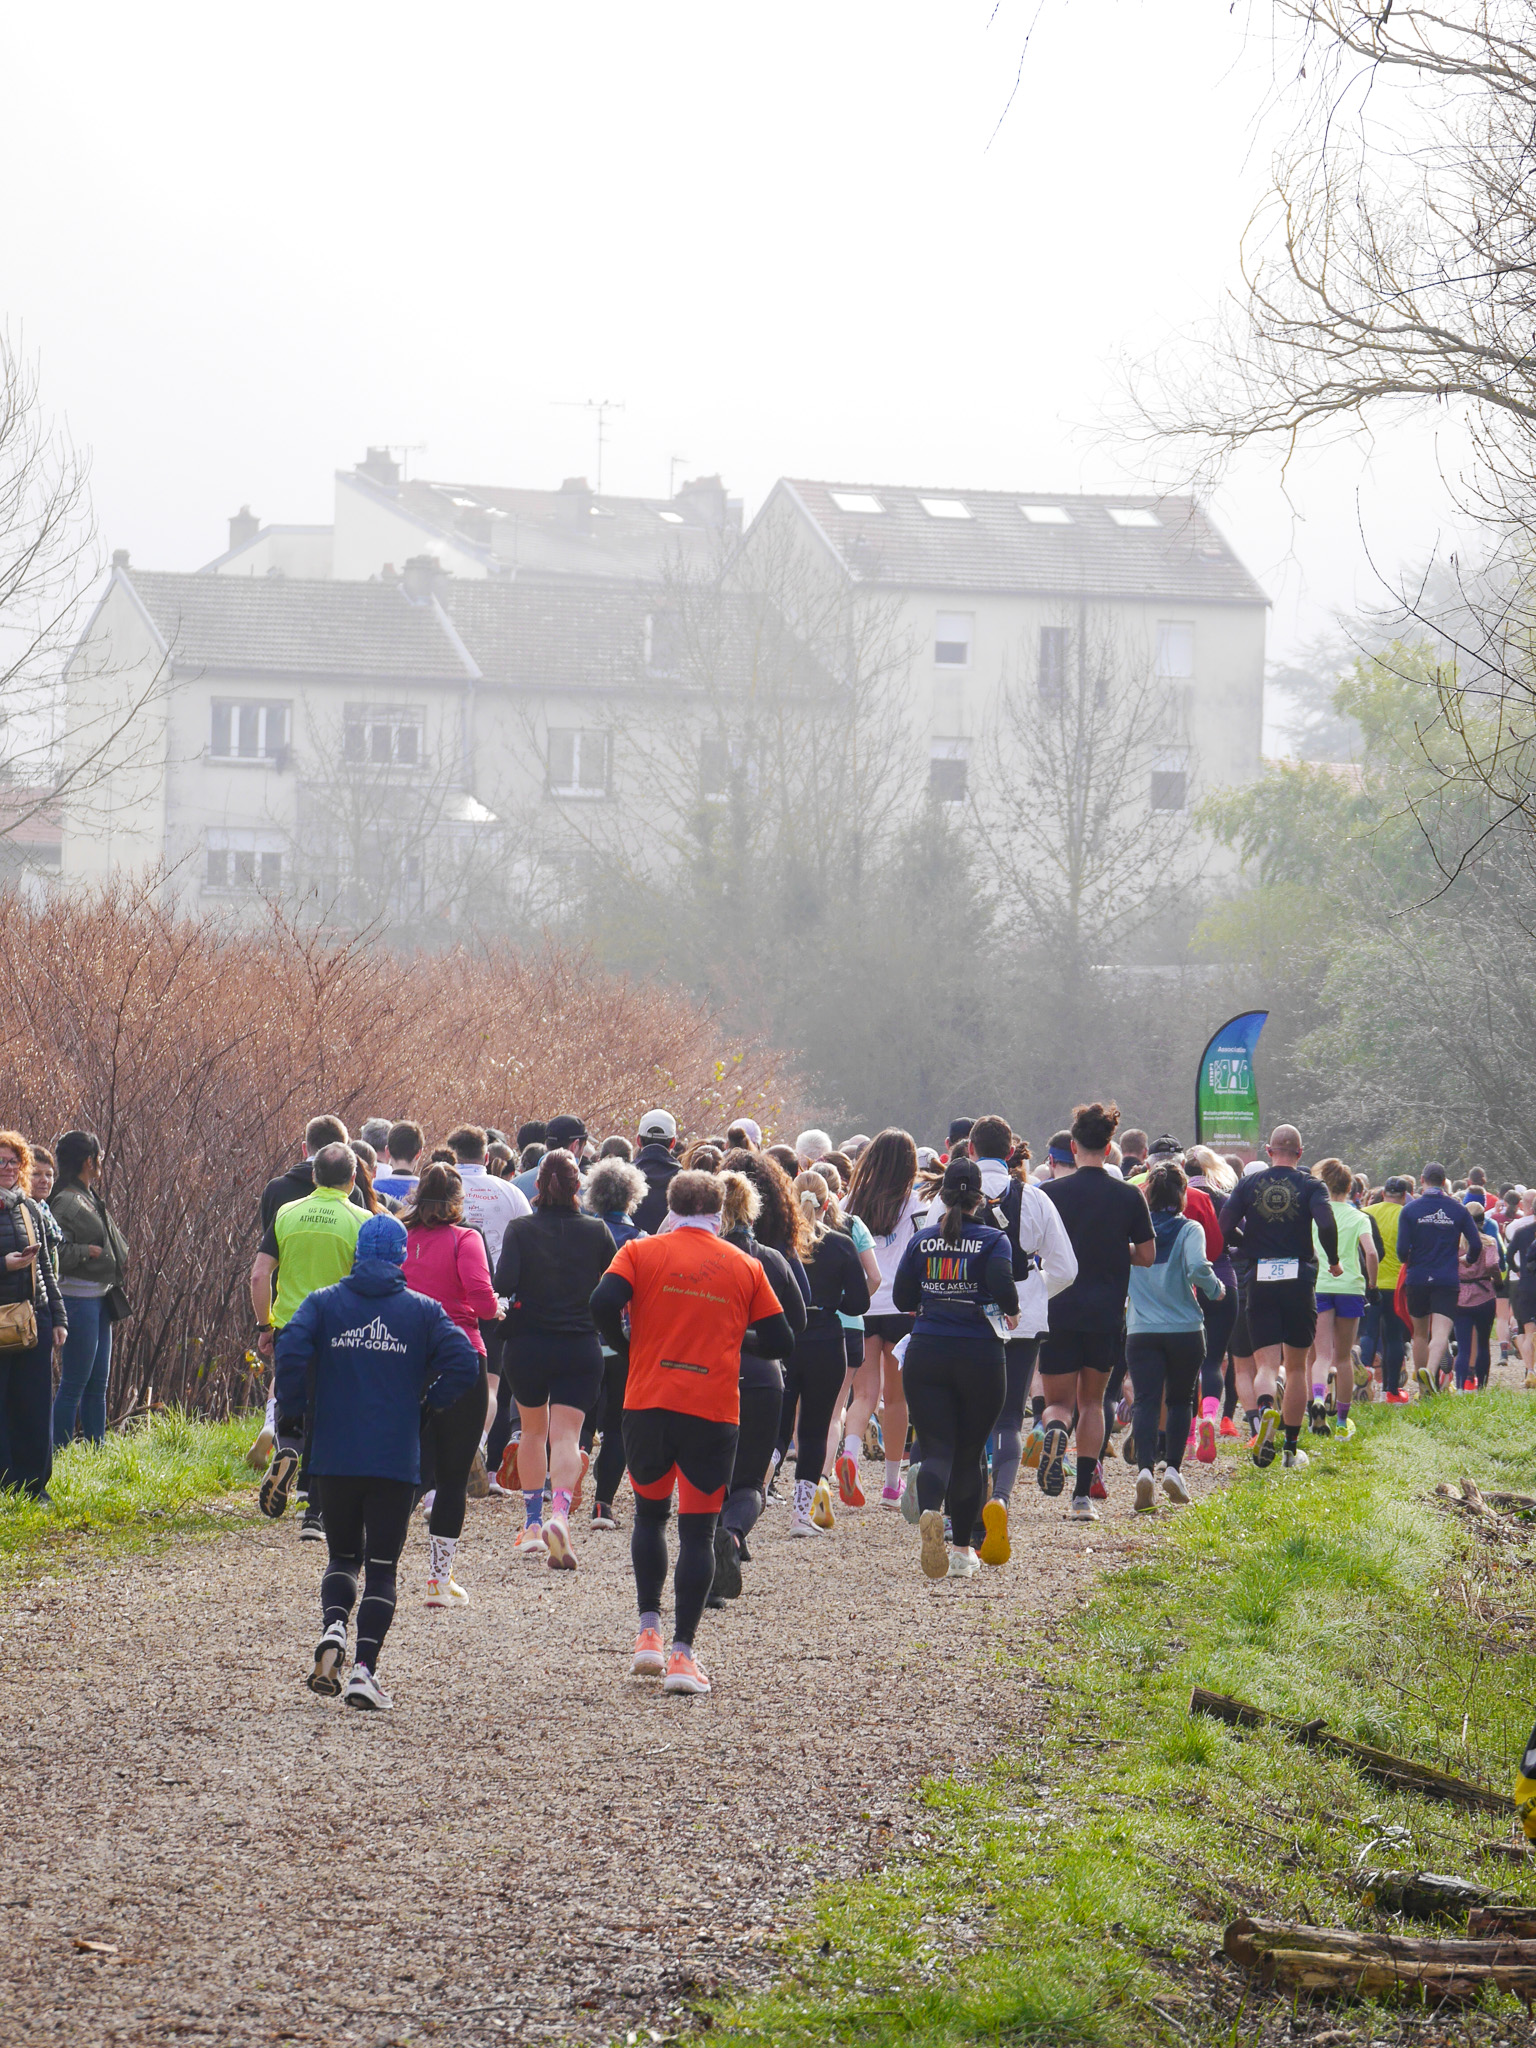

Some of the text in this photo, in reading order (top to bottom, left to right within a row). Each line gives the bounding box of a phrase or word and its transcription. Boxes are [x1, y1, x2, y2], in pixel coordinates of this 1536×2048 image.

[299, 1215, 338, 1225] ATHLETISME
[1417, 1217, 1455, 1225] SAINT-GOBAIN
[920, 1238, 984, 1253] CORALINE
[1271, 1264, 1284, 1276] 25
[331, 1337, 408, 1354] SAINT-GOBAIN
